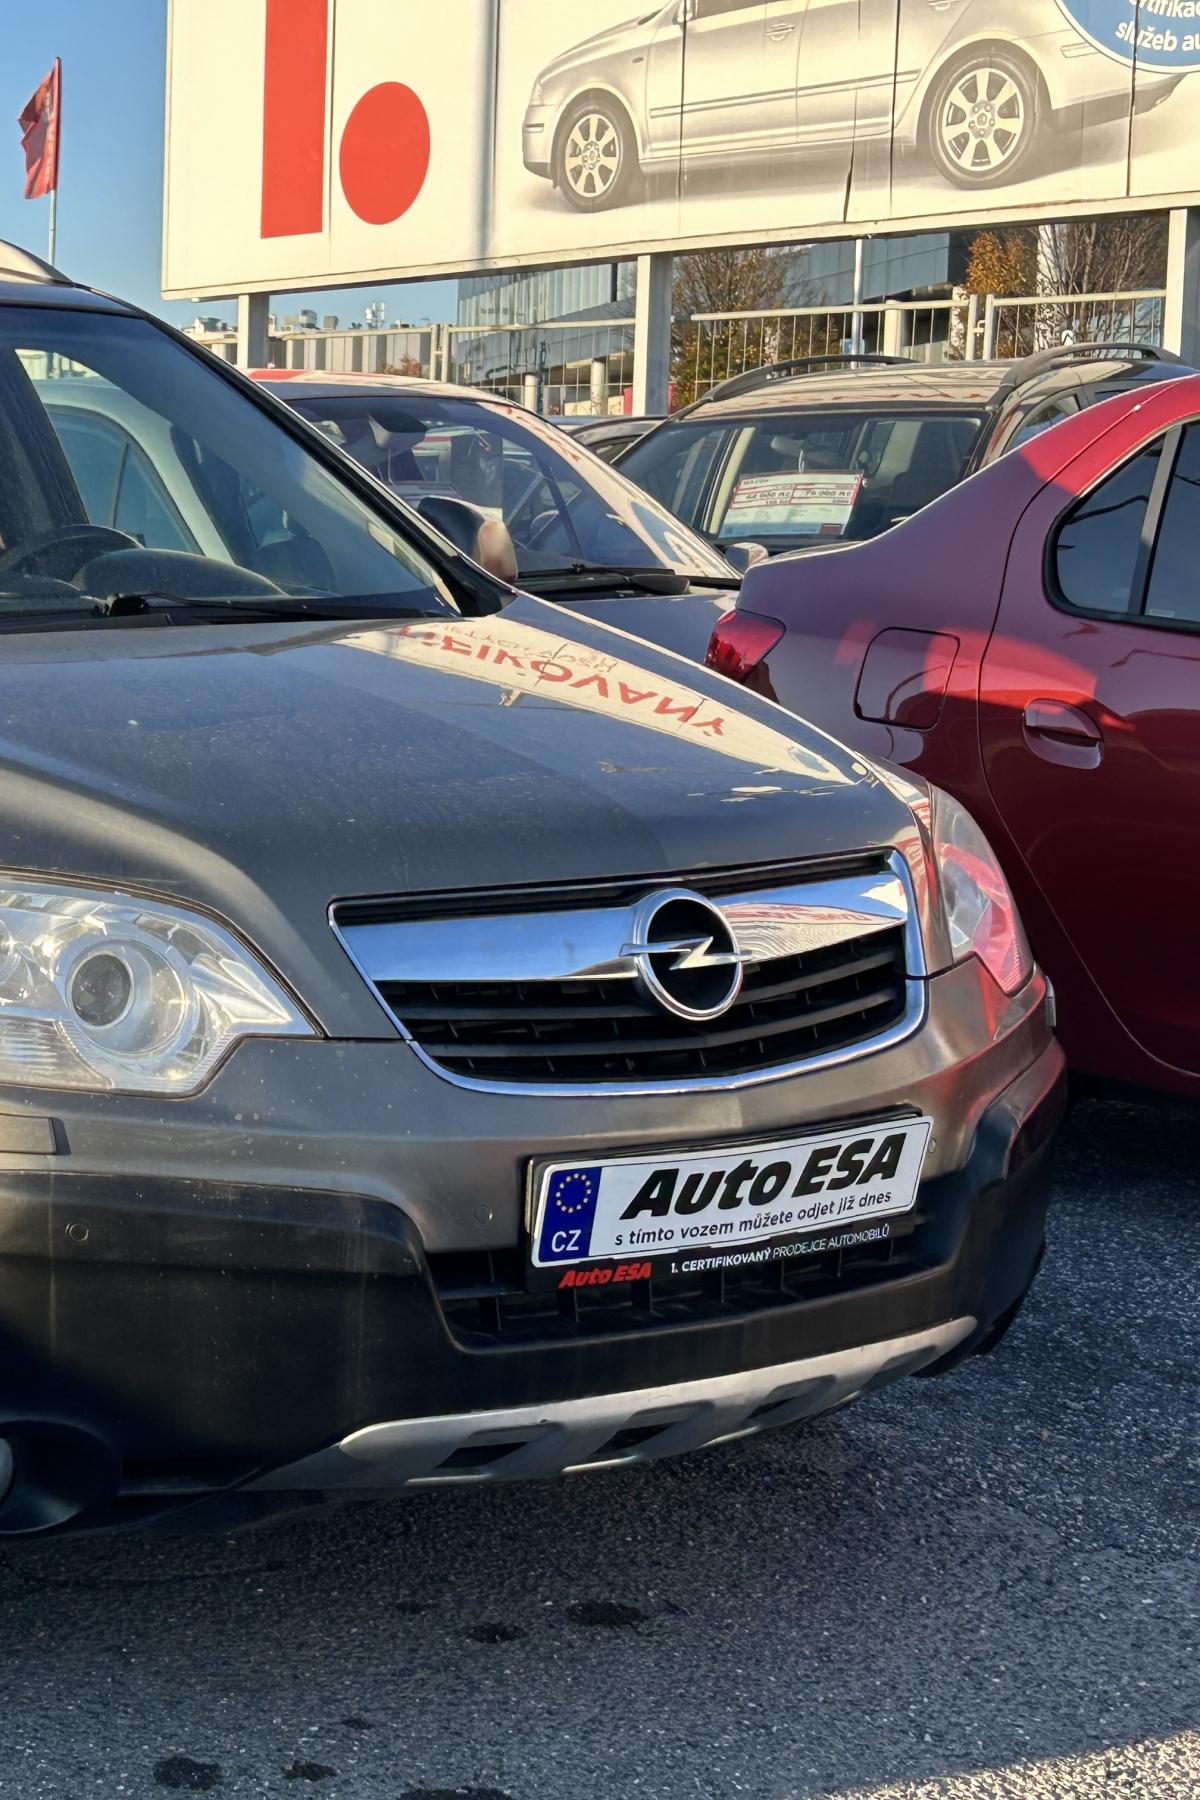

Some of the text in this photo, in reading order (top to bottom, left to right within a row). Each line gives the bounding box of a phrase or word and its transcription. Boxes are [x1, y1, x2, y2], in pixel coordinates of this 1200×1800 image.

[1129, 0, 1200, 18] tifika
[1114, 19, 1178, 52] služeb
[619, 1132, 907, 1220] Auto ESA
[615, 1191, 892, 1246] s tímto vozem můžete odjet již dnes
[551, 1229, 581, 1252] CZ
[671, 1262, 679, 1274] 1.
[681, 1247, 771, 1272] CERTIFIKOVANÝ
[772, 1238, 827, 1258] PRODEJCE
[558, 1262, 652, 1289] Auto ESA
